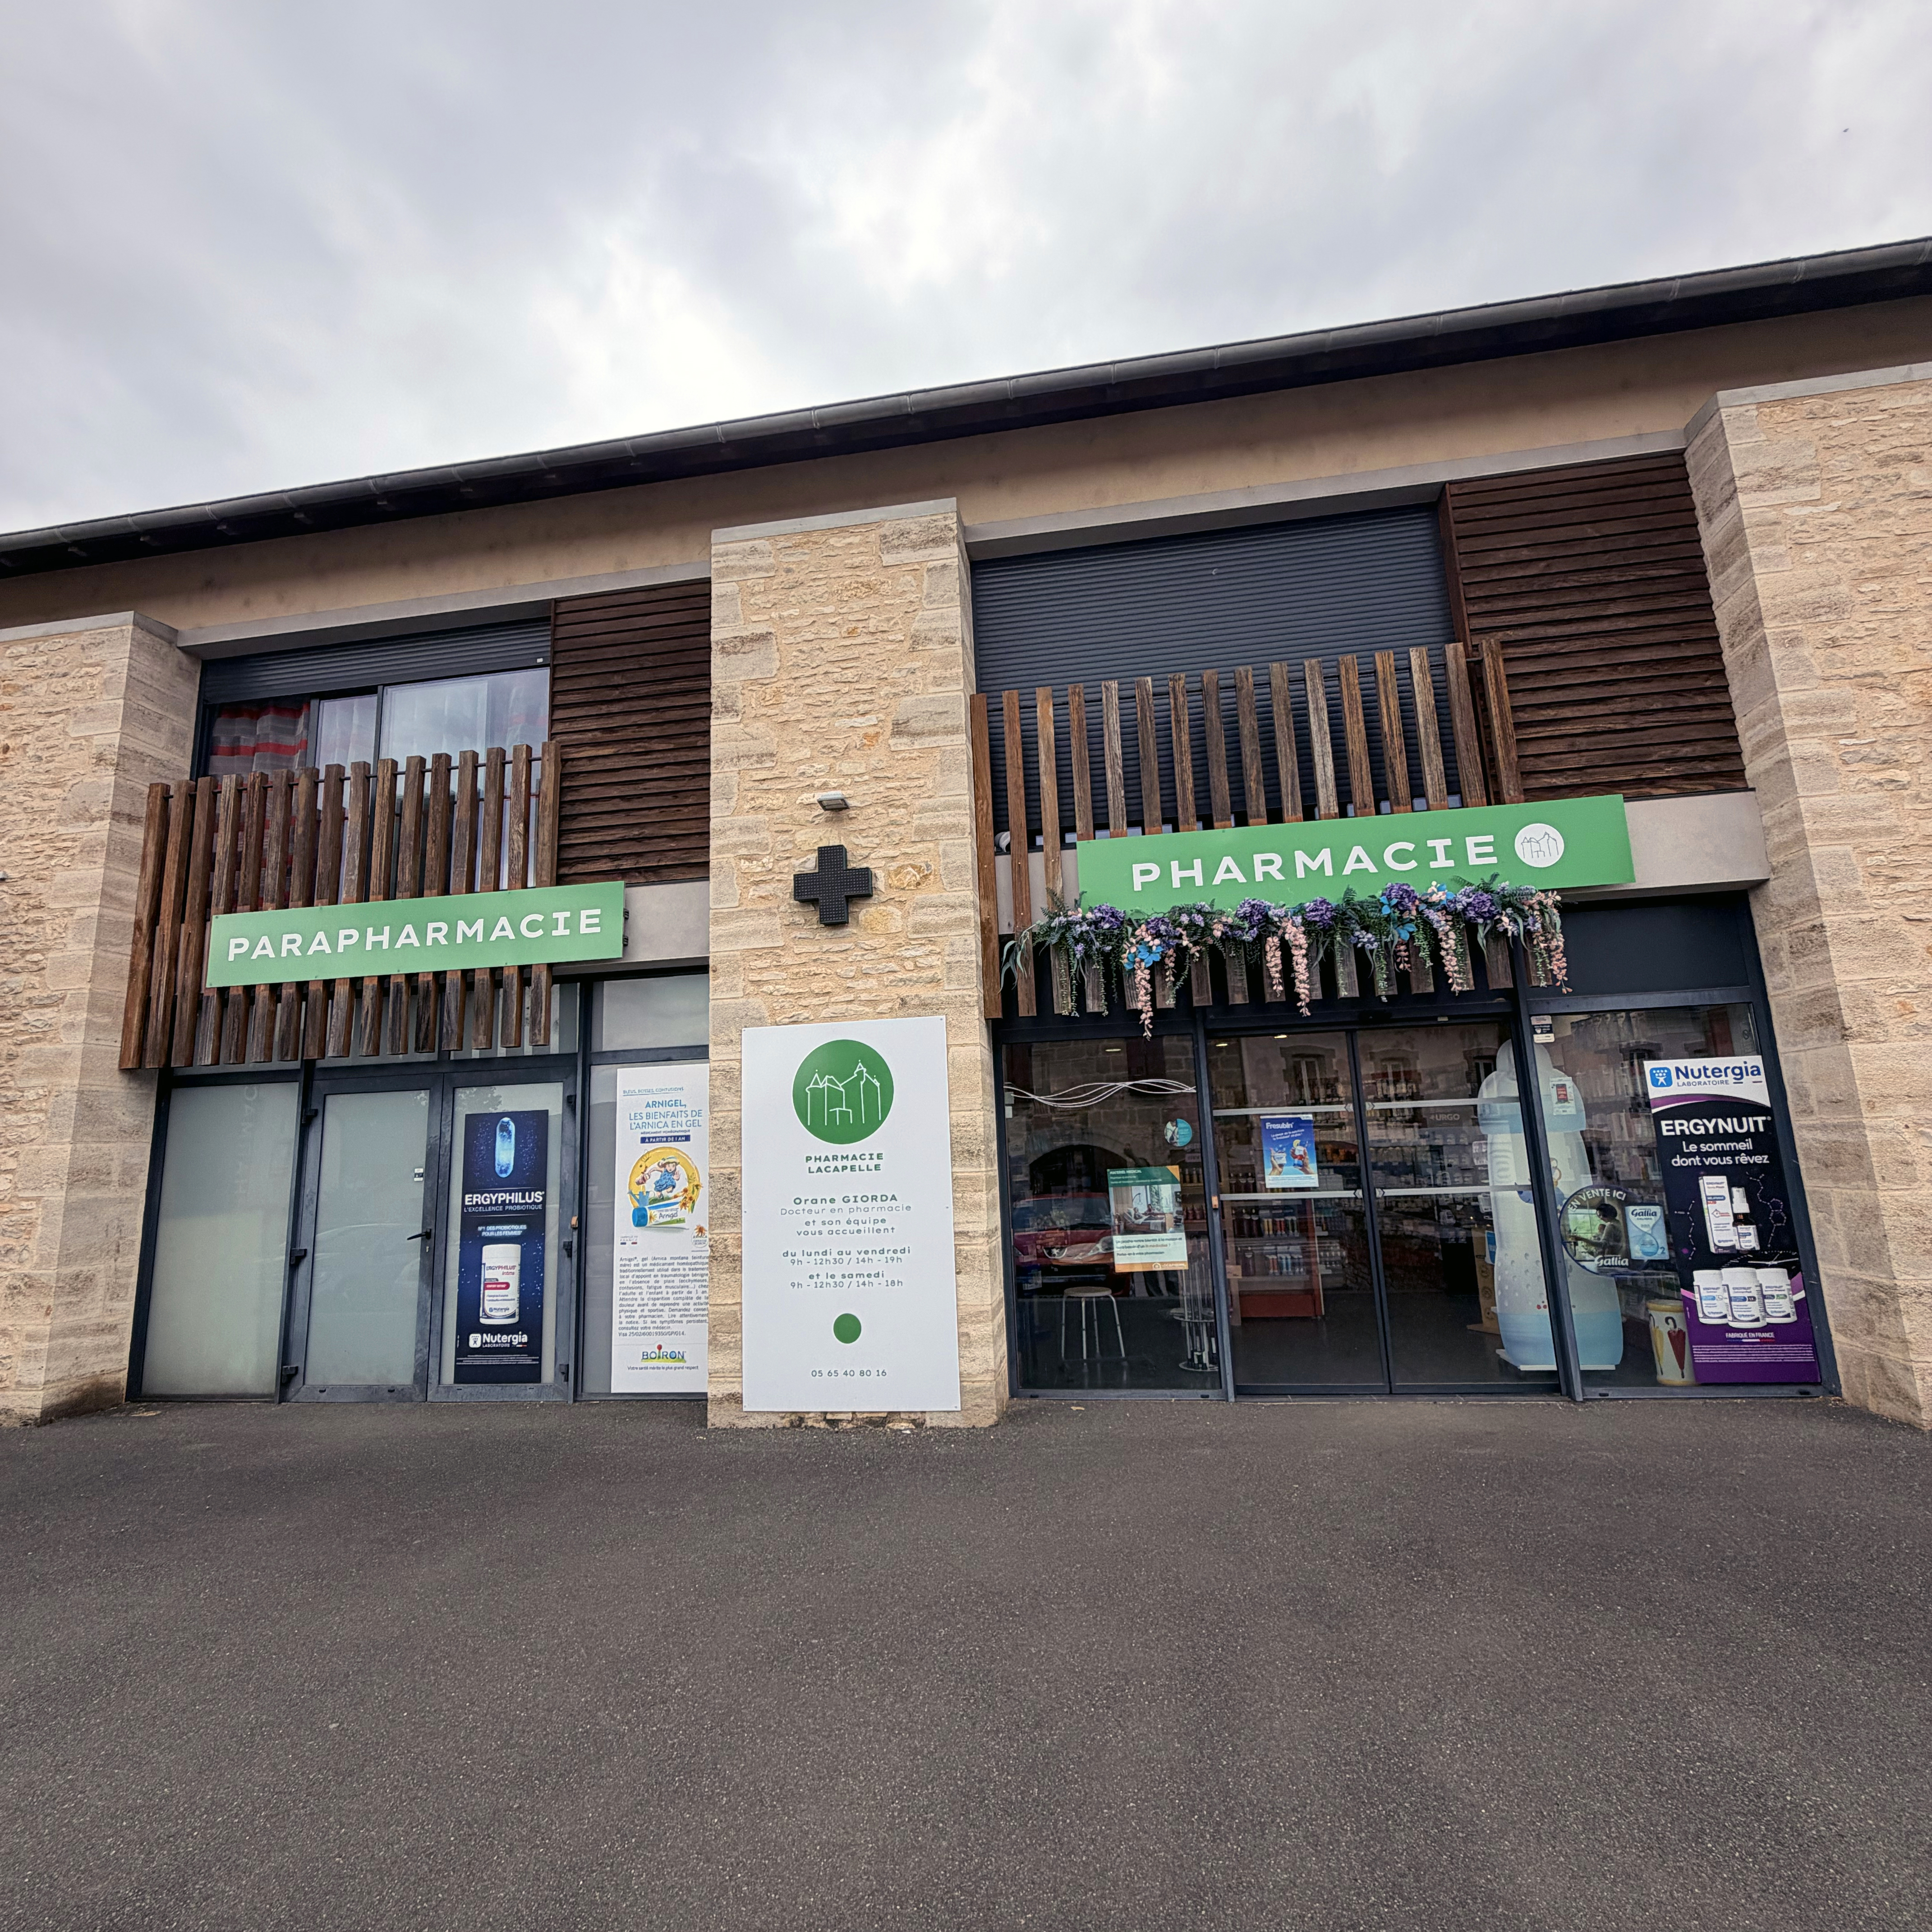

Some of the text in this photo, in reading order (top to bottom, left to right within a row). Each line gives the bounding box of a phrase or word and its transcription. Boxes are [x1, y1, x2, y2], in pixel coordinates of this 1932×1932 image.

[1132, 834, 1498, 892] PHARMACIE
[227, 908, 601, 961] PARAPHARMACIE
[1675, 1061, 1761, 1080] Nutergia
[645, 1099, 686, 1109] ARNIGEL,
[646, 1110, 688, 1119] BIENFAITS
[630, 1121, 668, 1130] L'ARNICA
[685, 1119, 702, 1127] GEL
[1683, 1139, 1753, 1152] Le sommeil
[806, 1153, 884, 1163] PHARMACIE
[1672, 1153, 1769, 1166] dont vous rêvez
[808, 1164, 881, 1173] LACAPELLE
[794, 1194, 898, 1205] Orane GIORDA
[1567, 1188, 1626, 1213] EN VENTE ICI
[781, 1207, 826, 1215] Docteur
[848, 1204, 911, 1214] pharmacie
[1631, 1209, 1657, 1217] Gallia
[846, 1217, 887, 1227] équipe
[828, 1226, 896, 1235] accueillent
[802, 1248, 832, 1257] lundi
[857, 1247, 911, 1256] vendredi
[1594, 1255, 1628, 1266] Gallia
[483, 1331, 527, 1345] Nutergia
